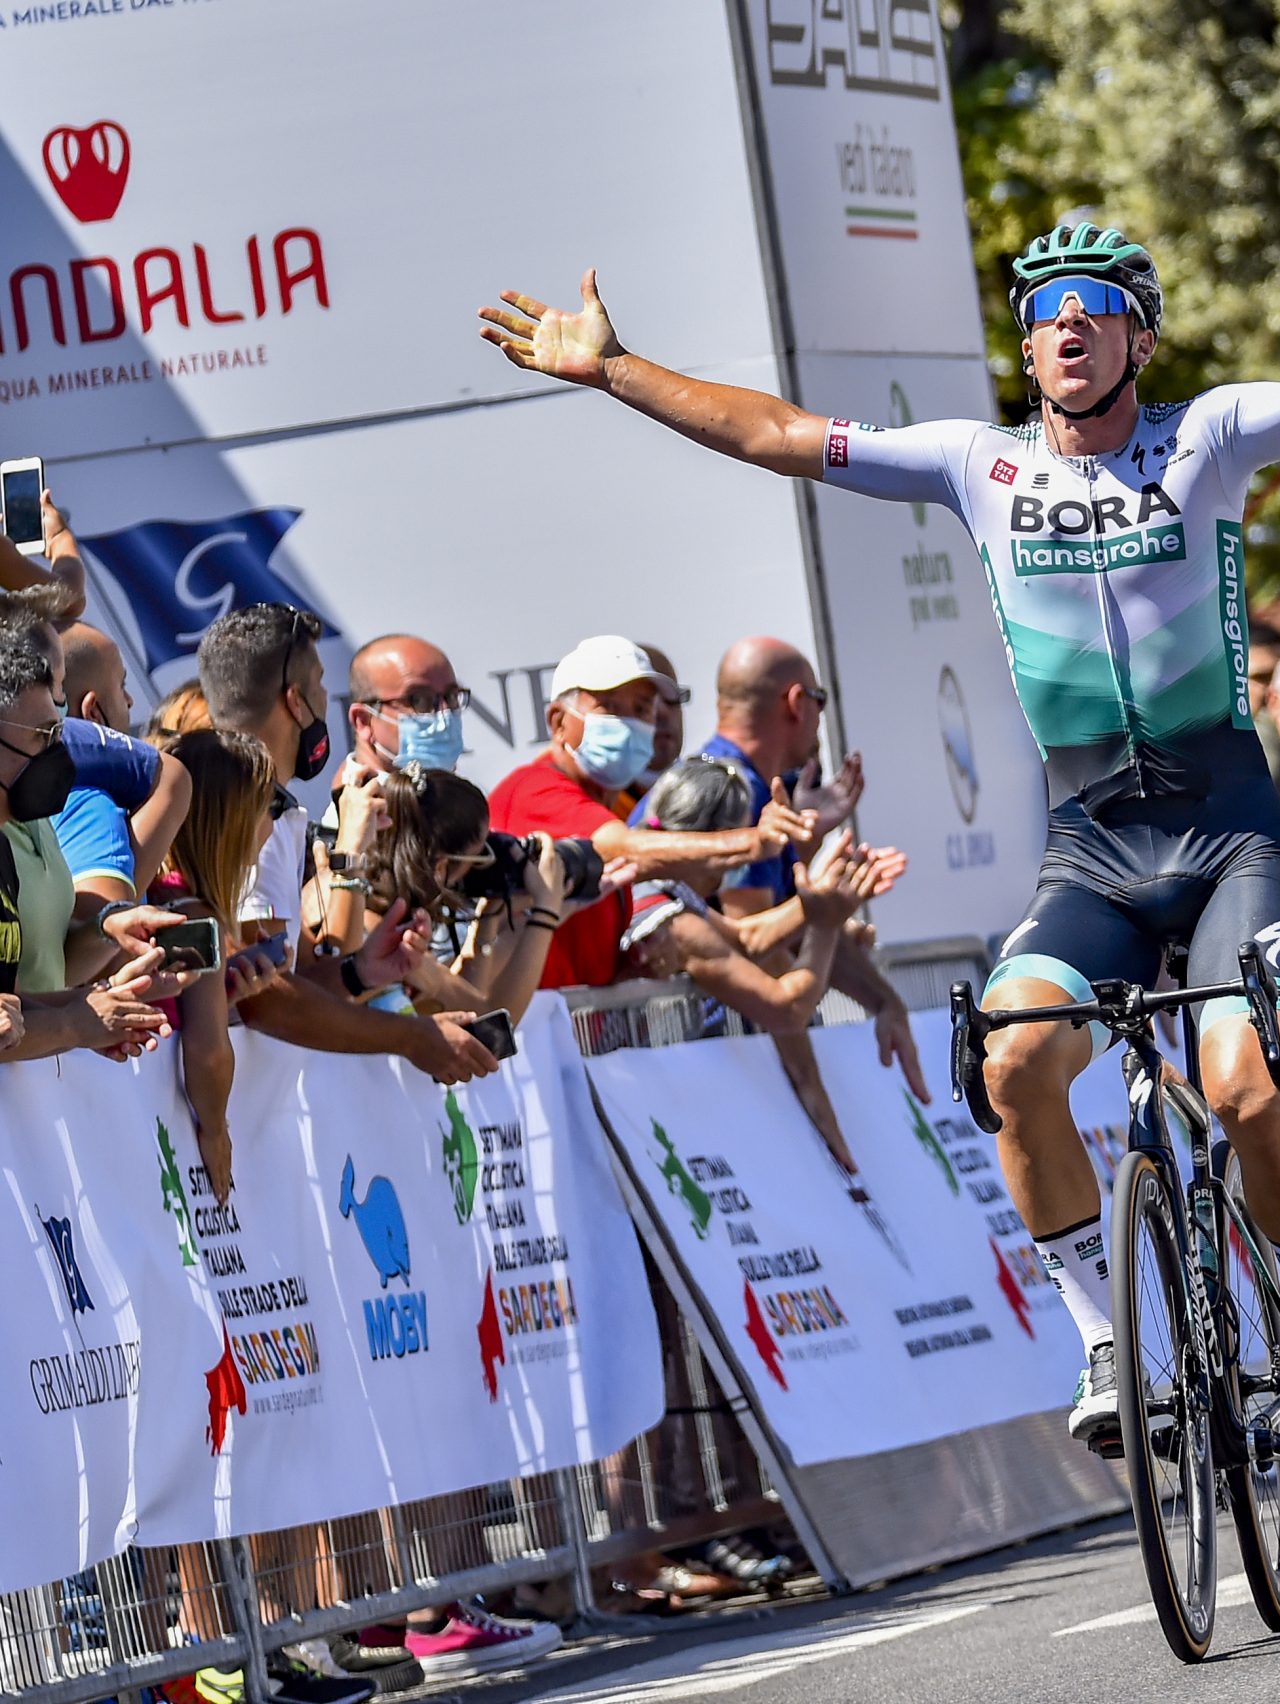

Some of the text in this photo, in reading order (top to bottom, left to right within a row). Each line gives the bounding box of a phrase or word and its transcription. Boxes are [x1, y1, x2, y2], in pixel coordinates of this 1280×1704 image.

[12, 0, 124, 27] MINERALE
[0, 226, 331, 355] NDALIA
[48, 361, 153, 394] MINERALE
[160, 344, 268, 378] NATURALE
[993, 471, 1011, 482] TAL
[995, 462, 1015, 476] ÖTZ
[1010, 481, 1182, 536] BORA
[1015, 527, 1181, 570] hansgrohe
[1221, 530, 1250, 718] hansgrohe
[362, 1290, 429, 1361] MOBY
[29, 1345, 112, 1415] GRIMALDI
[231, 1321, 321, 1386] SARDEGNA
